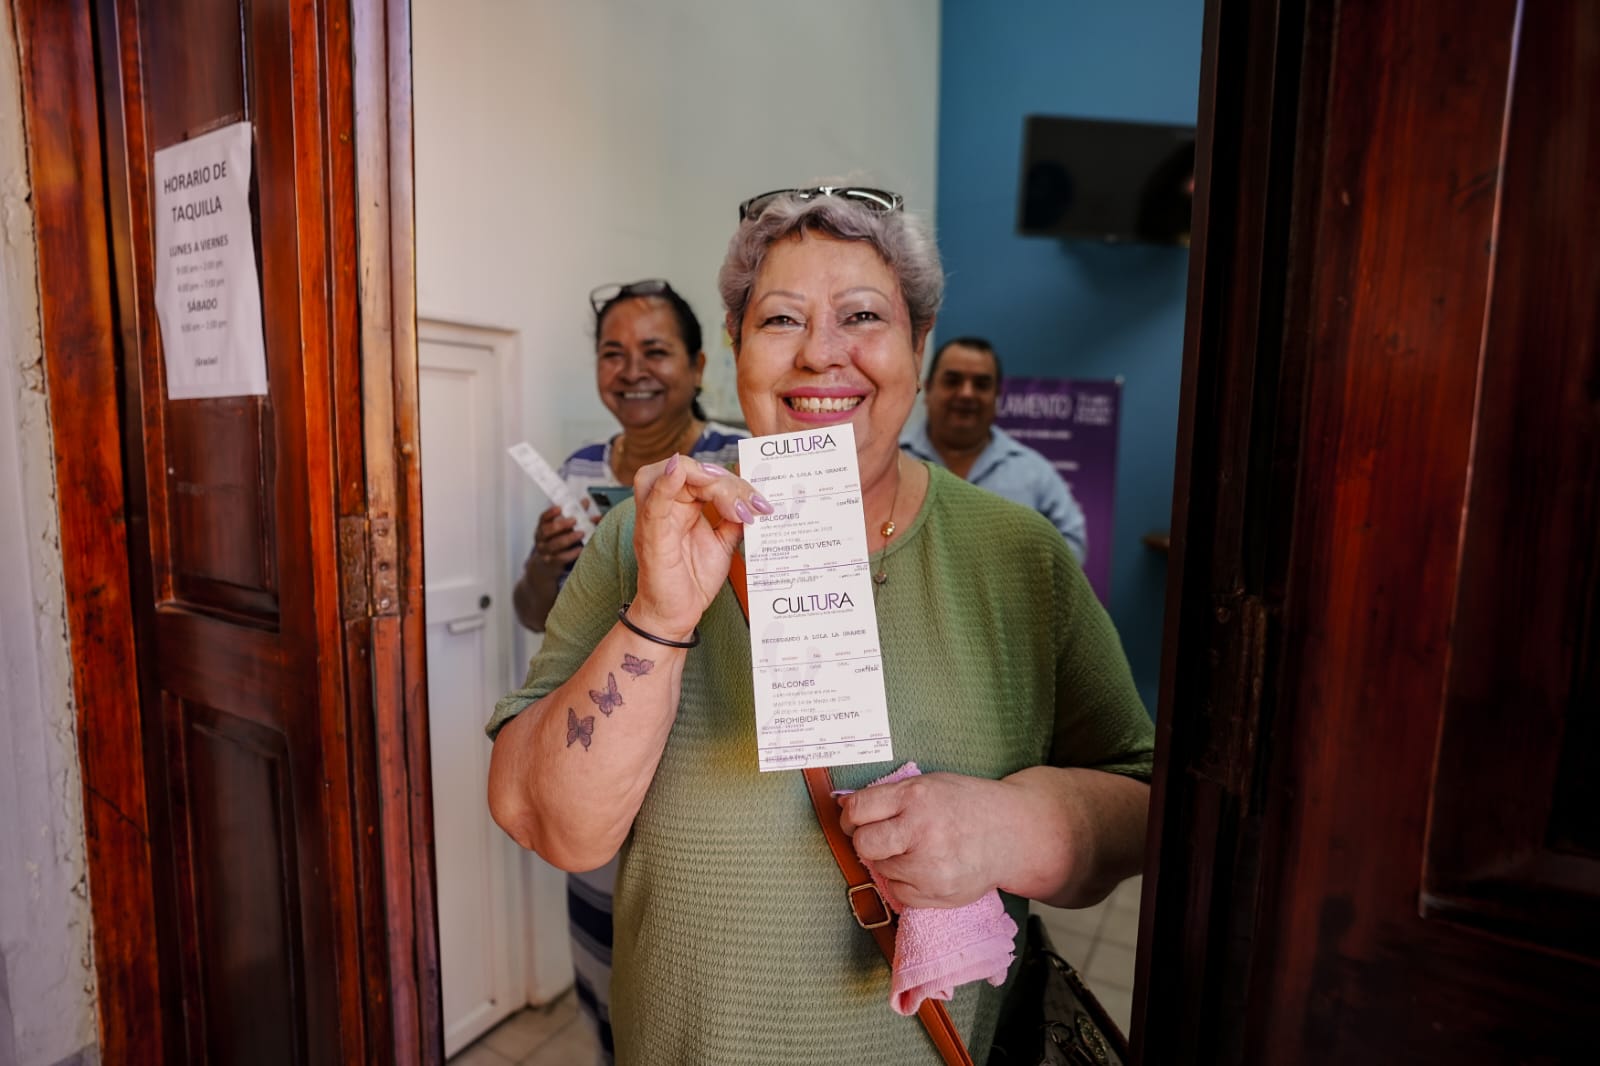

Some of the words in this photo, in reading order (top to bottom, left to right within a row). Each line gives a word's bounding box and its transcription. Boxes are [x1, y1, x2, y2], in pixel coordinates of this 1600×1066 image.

[163, 166, 210, 194] HORARIO
[213, 160, 227, 181] DE
[172, 195, 223, 223] TAQUILLA
[169, 243, 193, 257] LUNES
[194, 243, 199, 252] A
[200, 234, 229, 251] VIERNES
[760, 434, 837, 456] CULTURA
[759, 512, 799, 522] BALCONES
[761, 543, 802, 553] PROHIBIDA
[815, 539, 841, 547] VENTA
[772, 592, 855, 614] CULTURA
[771, 678, 815, 689] BALCONES
[774, 714, 819, 725] PROHIBIDA
[820, 713, 831, 721] SU
[832, 710, 859, 720] VENTA
